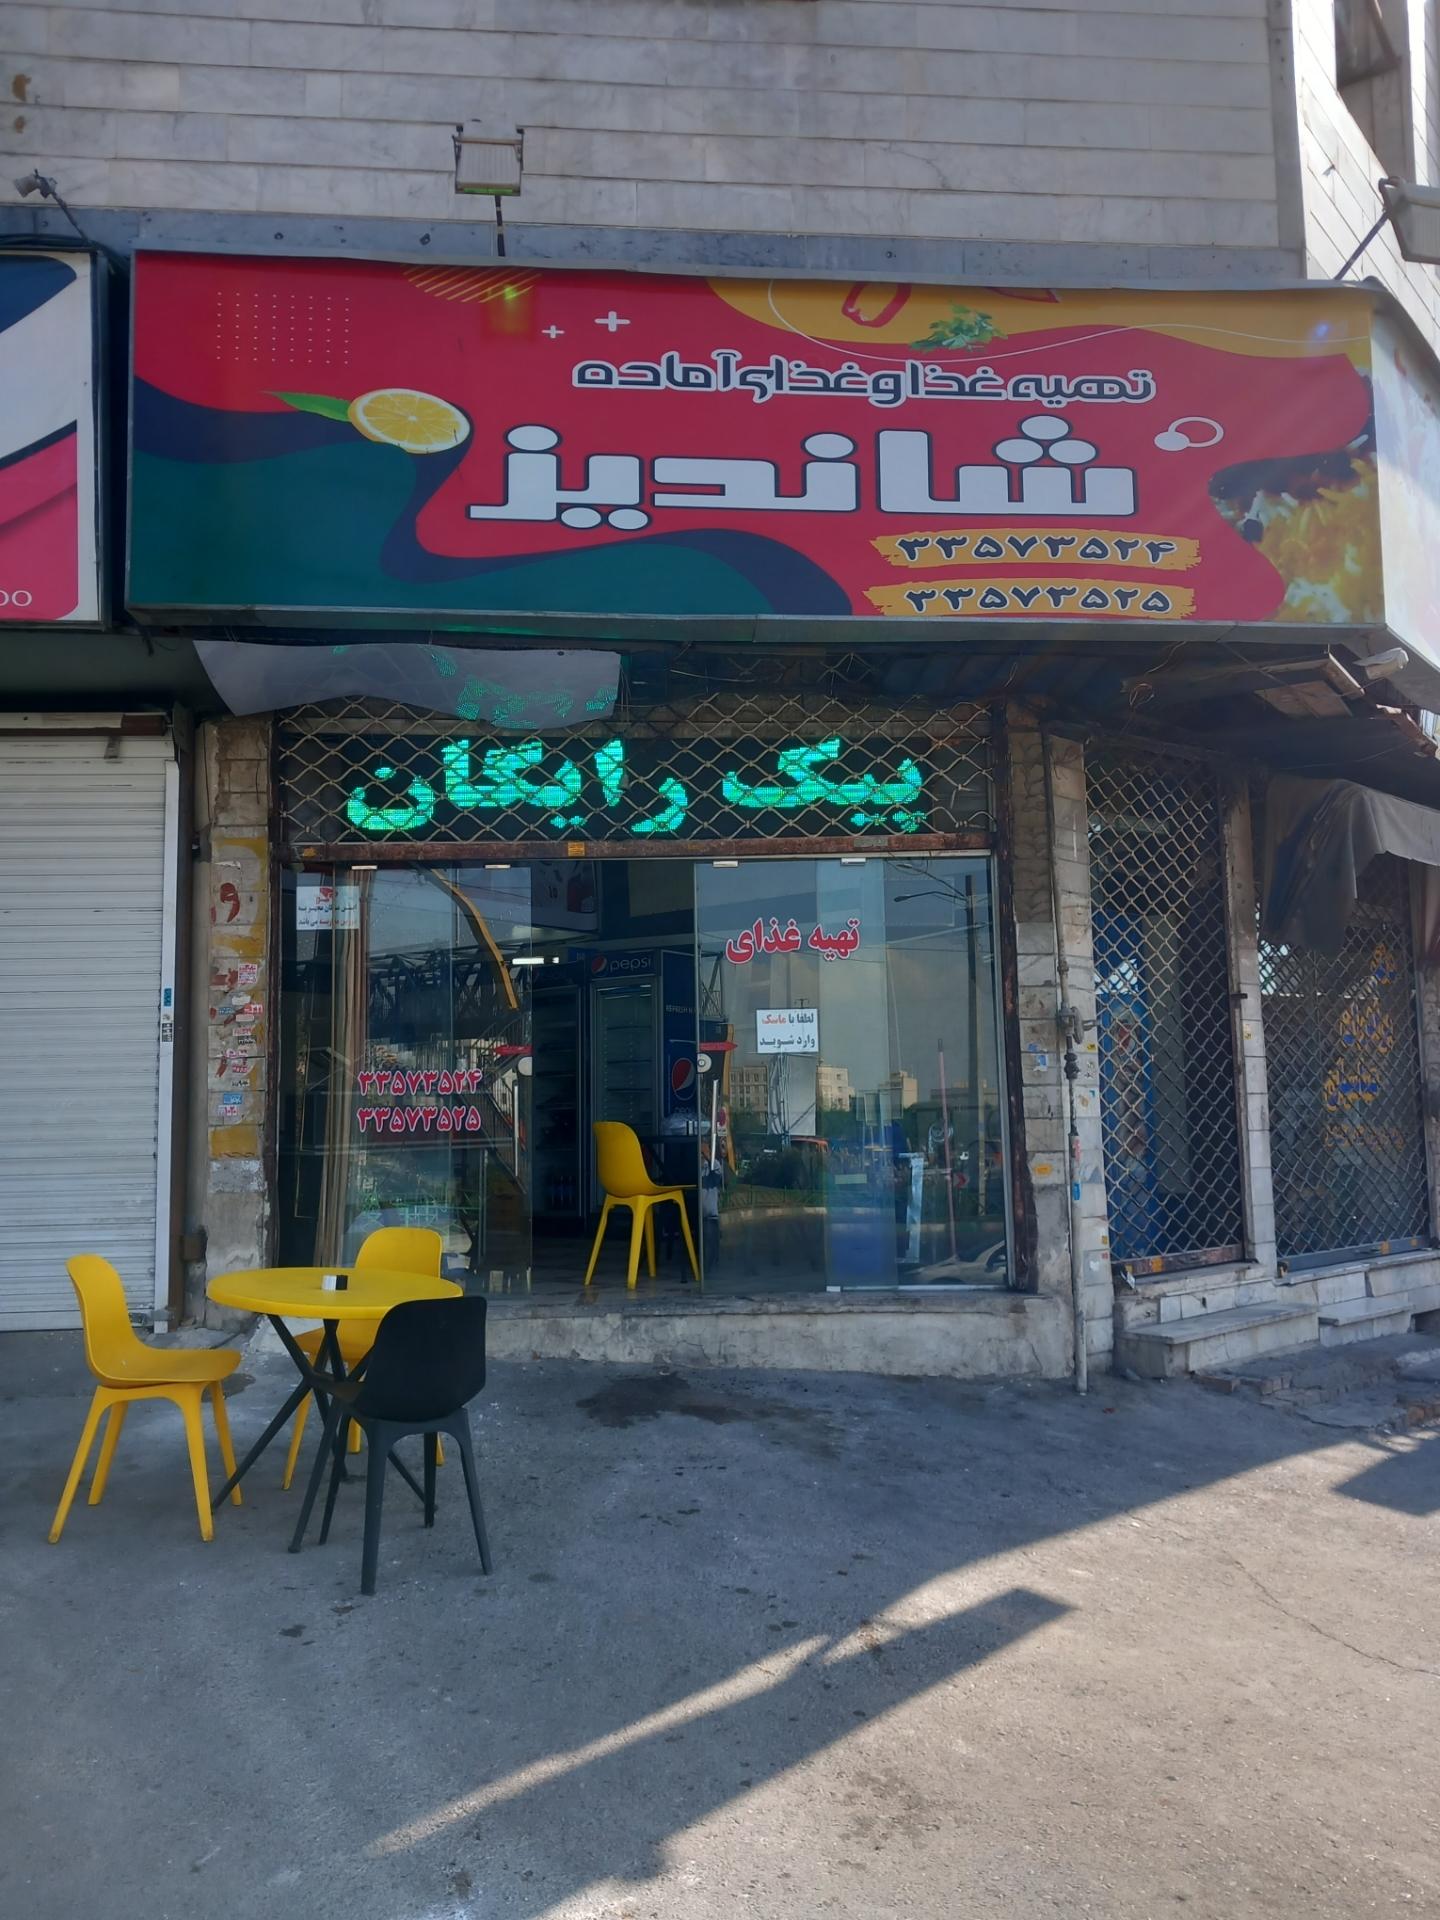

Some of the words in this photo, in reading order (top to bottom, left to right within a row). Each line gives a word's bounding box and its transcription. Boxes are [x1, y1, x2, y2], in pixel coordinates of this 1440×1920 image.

[571, 348, 742, 393] آماده
[1007, 369, 1157, 408] تهیه
[467, 414, 1139, 531] شاندیز
[896, 534, 1178, 564] ۳۳۵۷۳۵۲۴
[904, 585, 1173, 613] ۳۳۵۷۳۵۲۵
[347, 738, 688, 833] رایگان
[722, 738, 927, 832] پیک
[726, 917, 801, 964] غذای
[808, 918, 861, 961] تهیه
[796, 1034, 815, 1049] وارد
[357, 1068, 483, 1096] ۳۳۵۷۳۵۲۴
[356, 1105, 481, 1133] ۳۳۵۷۳۵۲۵
